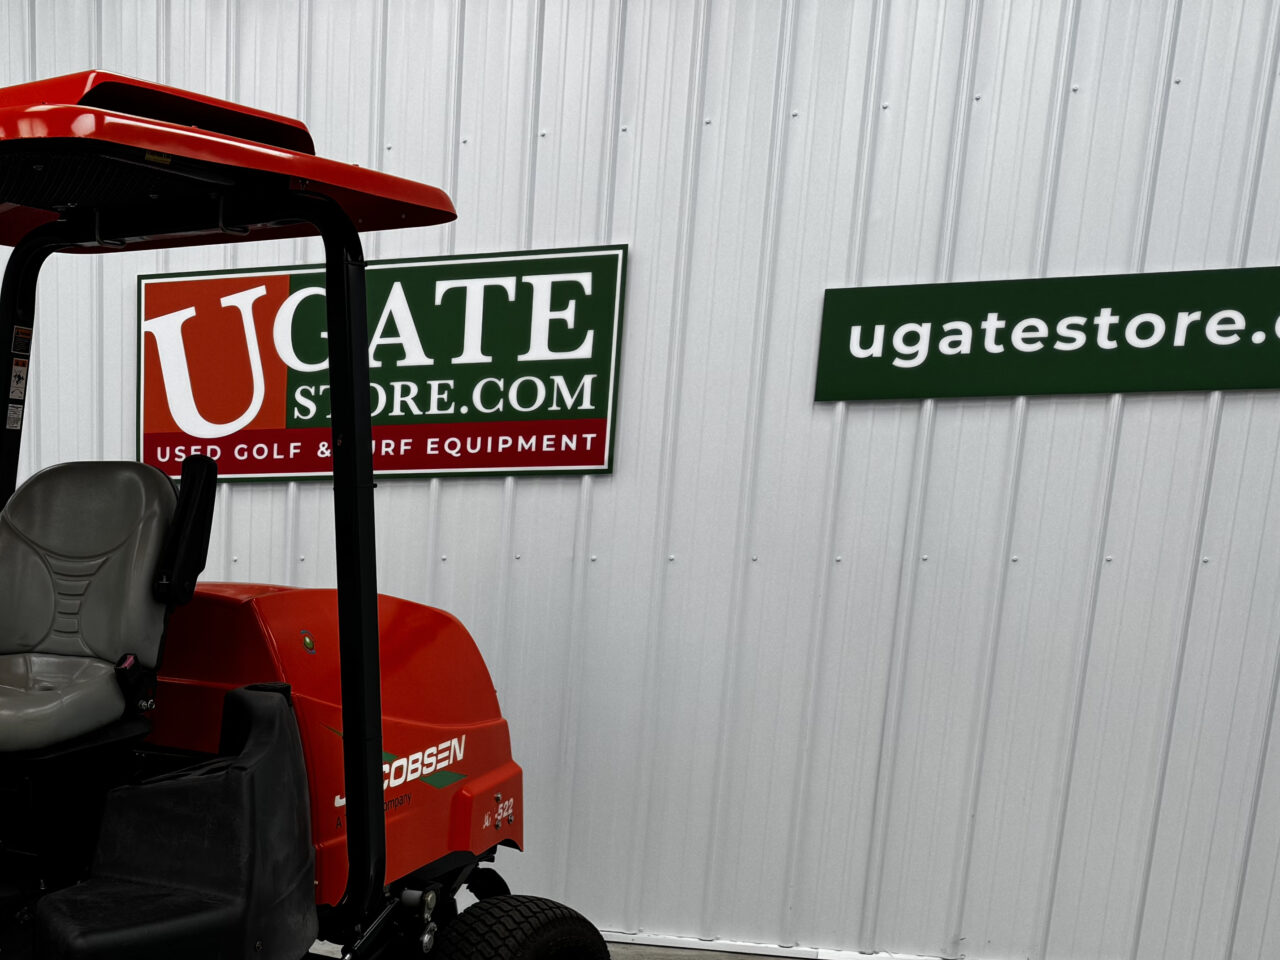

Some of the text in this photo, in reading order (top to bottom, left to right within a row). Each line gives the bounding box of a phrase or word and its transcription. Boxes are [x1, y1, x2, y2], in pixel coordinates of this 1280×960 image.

[849, 308, 1280, 368] ugatestore.
[156, 445, 221, 462] USED
[233, 441, 302, 460] GOLF
[317, 441, 332, 458] &
[426, 433, 597, 457] EQUIPMENT
[383, 792, 412, 813] ompany
